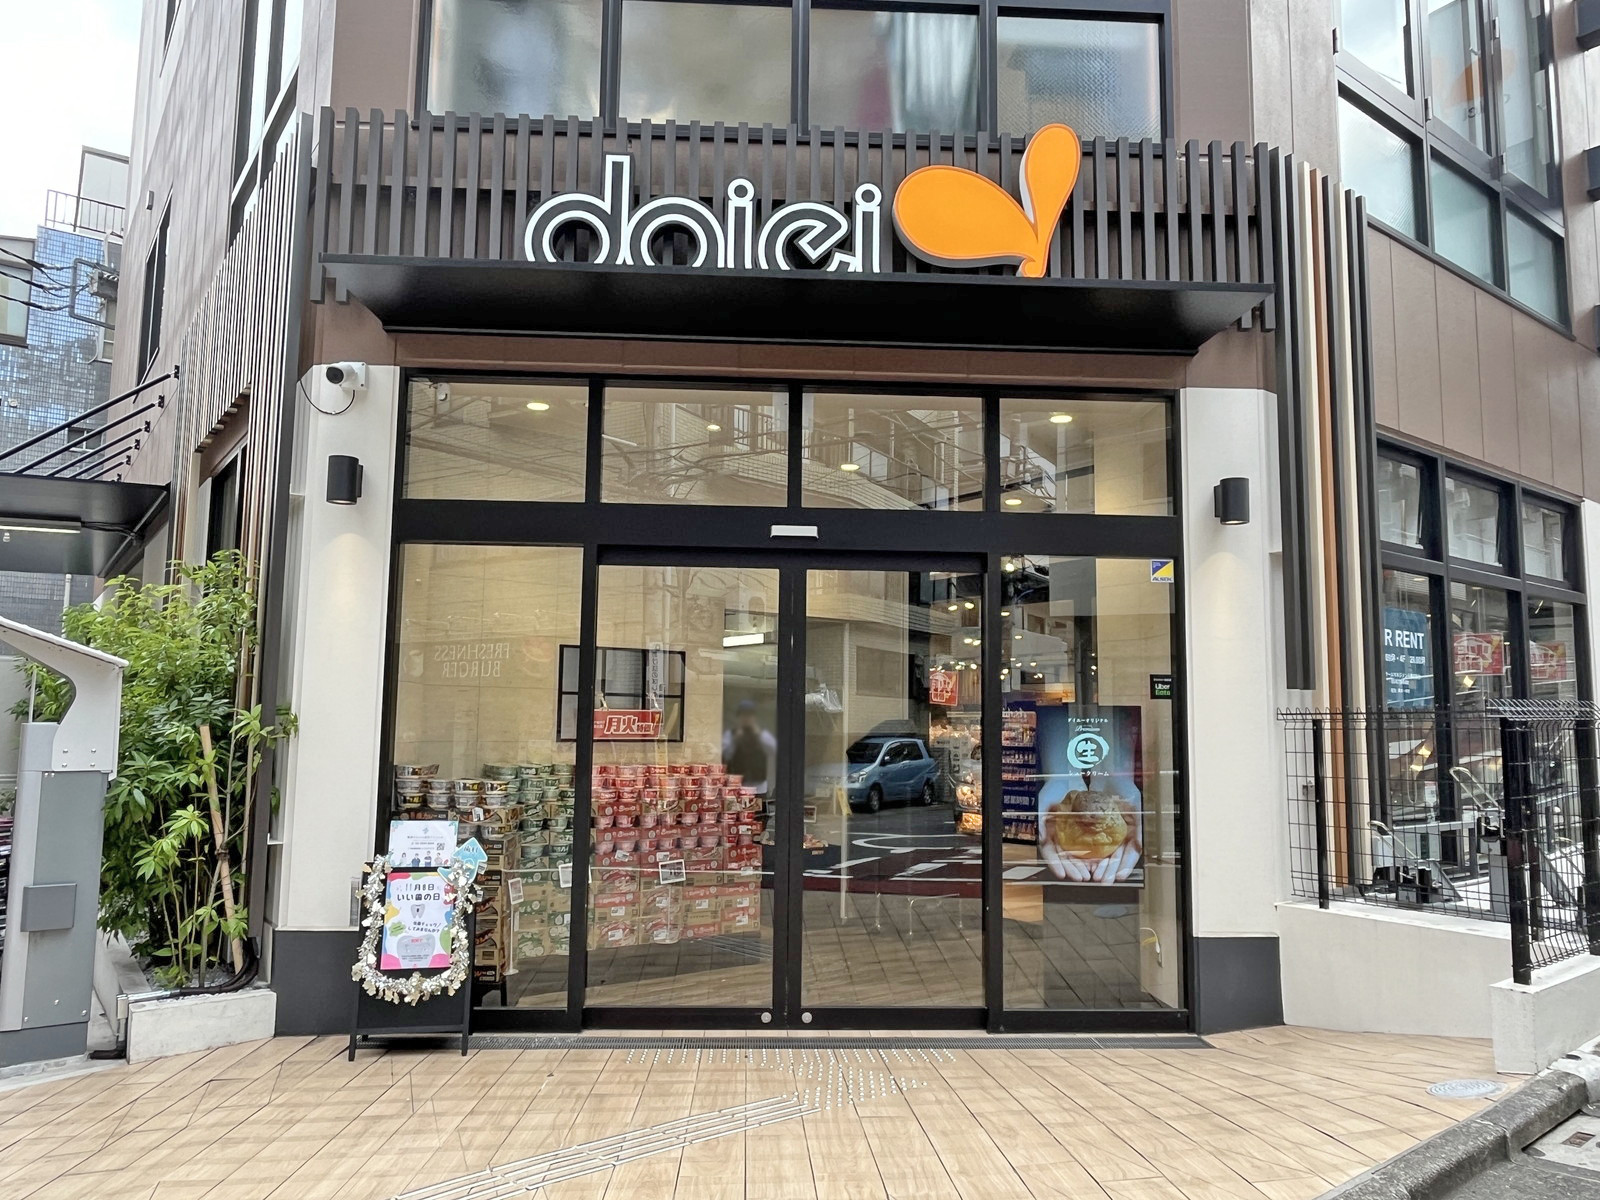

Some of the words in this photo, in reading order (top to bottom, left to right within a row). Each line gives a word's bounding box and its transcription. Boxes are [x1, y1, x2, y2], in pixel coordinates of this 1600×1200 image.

[524, 154, 882, 273] daiei
[1395, 630, 1425, 650] RENT
[1076, 740, 1100, 763] 生
[397, 892, 440, 901] いい歯の日
